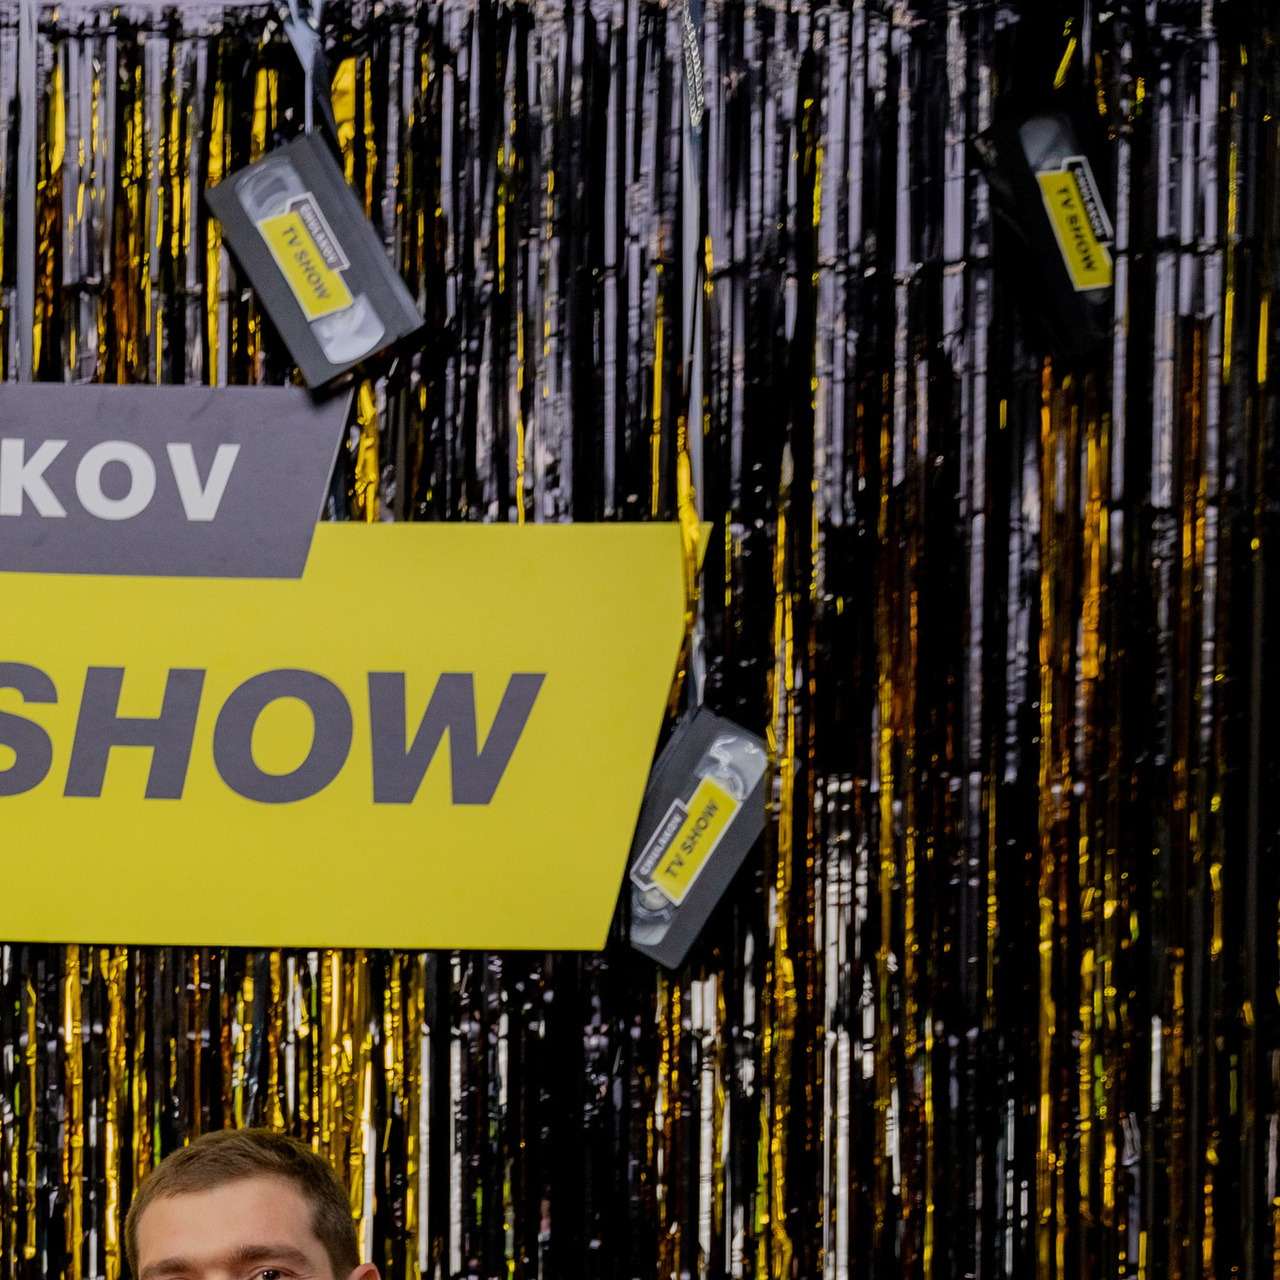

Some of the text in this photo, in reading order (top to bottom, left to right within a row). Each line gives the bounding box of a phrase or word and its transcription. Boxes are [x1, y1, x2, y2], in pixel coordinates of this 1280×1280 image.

[281, 227, 331, 300] TV SHOW
[299, 203, 339, 264] CHULAKOV
[1057, 187, 1098, 272] TV SHOW
[639, 813, 683, 876] CHULAKOV
[665, 799, 718, 878] TV SHOW
